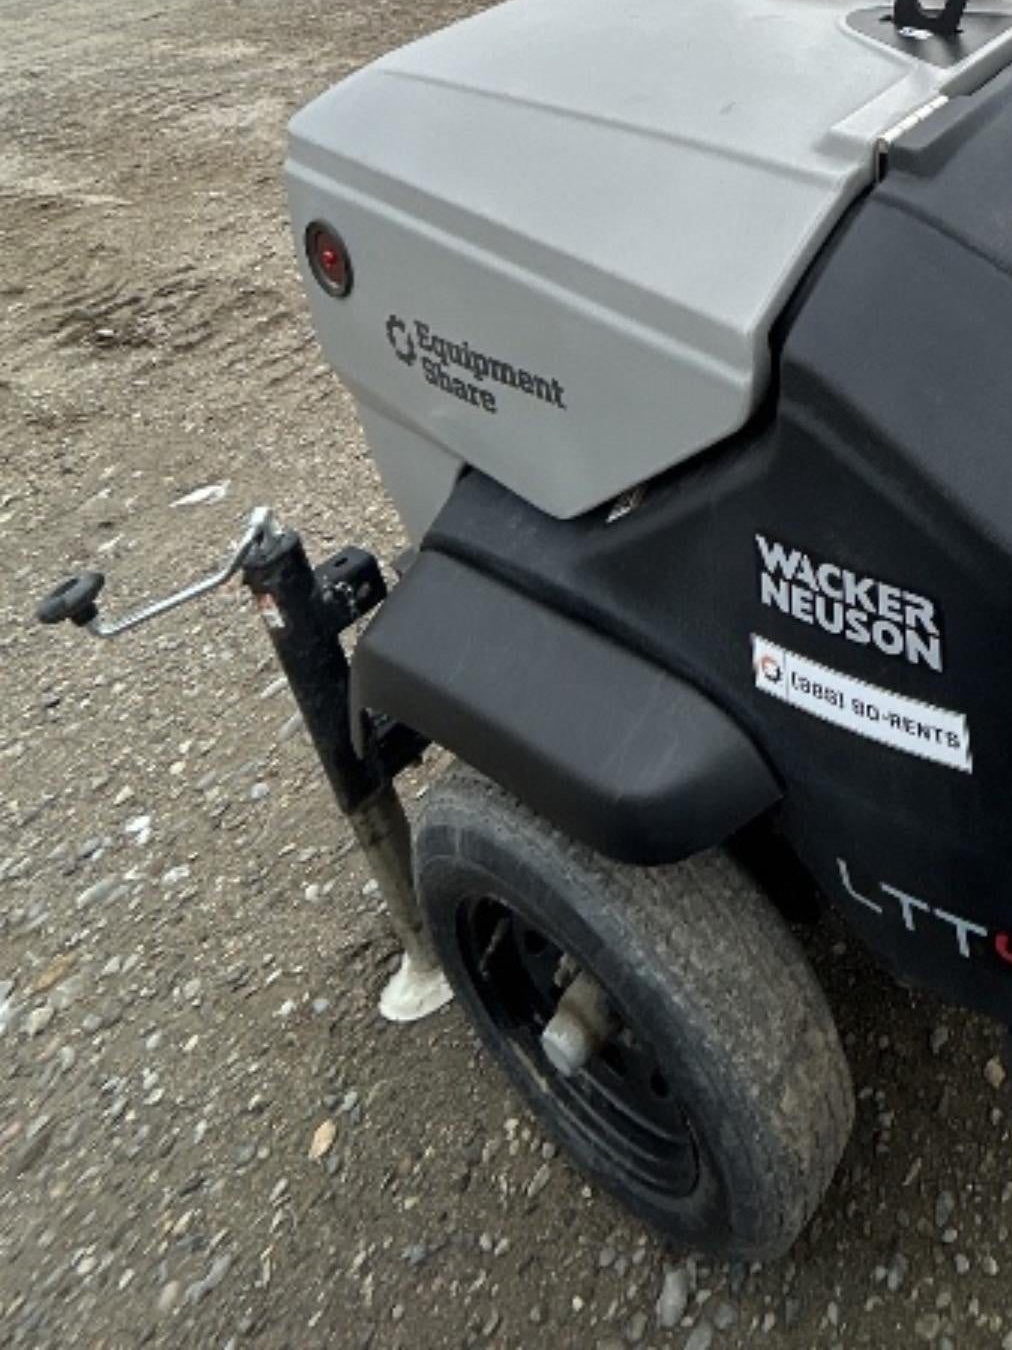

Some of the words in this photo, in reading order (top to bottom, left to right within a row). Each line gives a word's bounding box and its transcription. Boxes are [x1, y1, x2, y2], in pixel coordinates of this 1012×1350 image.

[413, 319, 567, 410] Equipment
[421, 356, 498, 414] Share
[755, 533, 940, 637] WACKER
[760, 571, 943, 674] NEUSON
